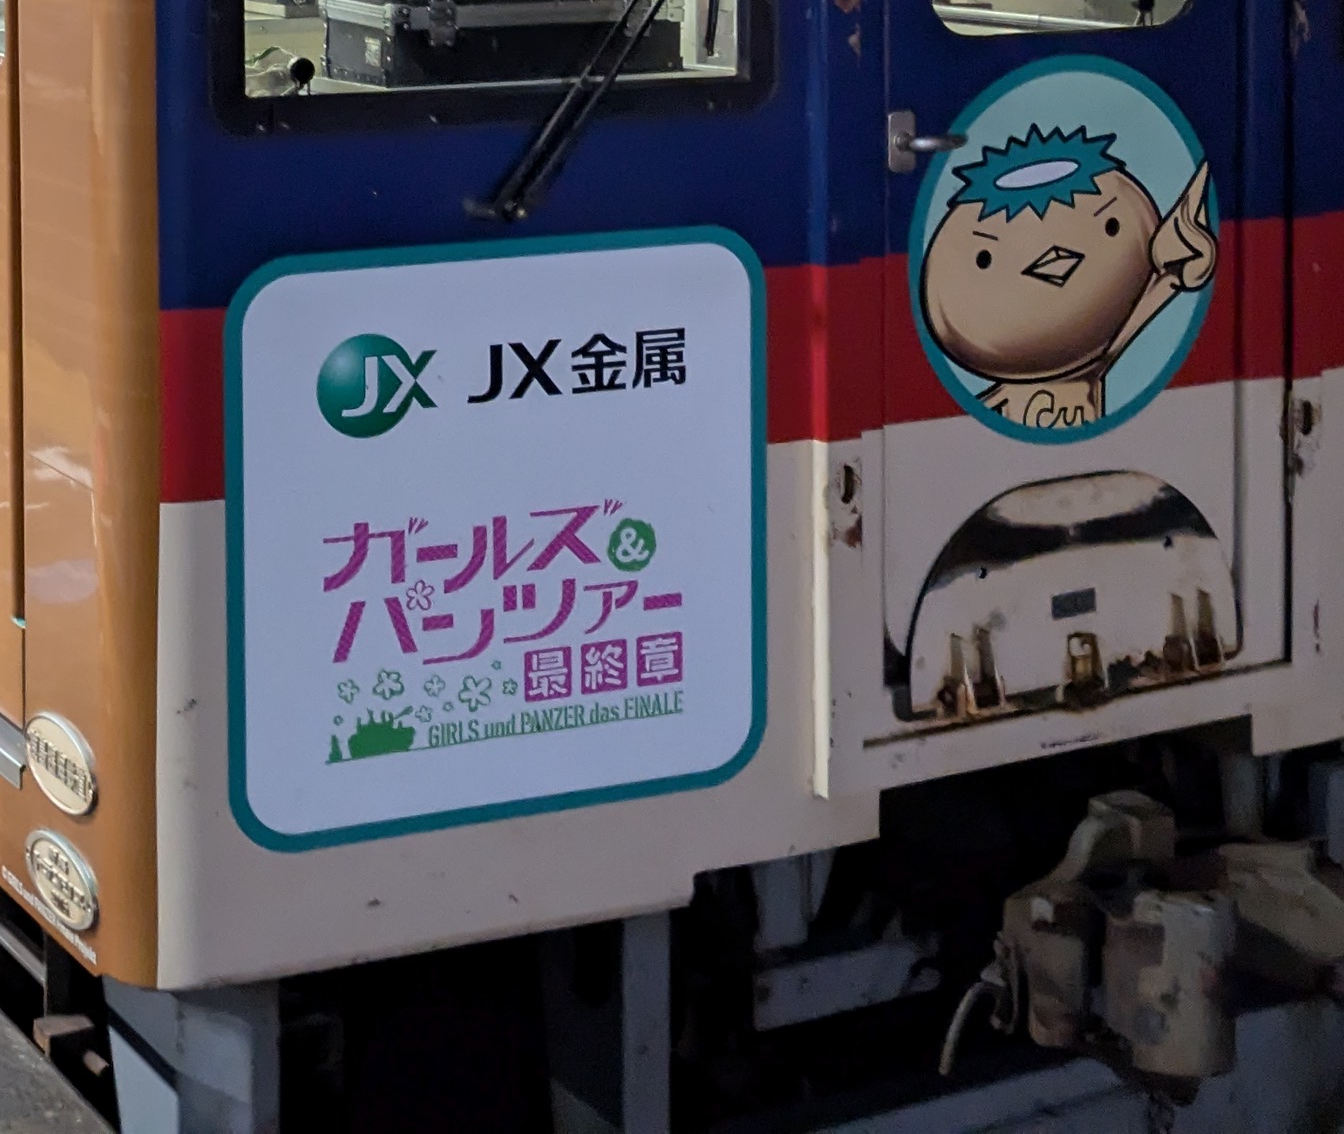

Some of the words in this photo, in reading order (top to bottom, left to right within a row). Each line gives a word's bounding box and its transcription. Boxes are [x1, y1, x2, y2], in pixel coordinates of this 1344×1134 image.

[341, 349, 438, 417] JX
[467, 327, 687, 404] JX金属
[525, 631, 683, 702] 最終章
[427, 718, 480, 748] GIRLS
[484, 713, 515, 738] und
[519, 703, 586, 734] PANZER
[589, 701, 620, 726] das
[623, 689, 684, 721] FINALE
